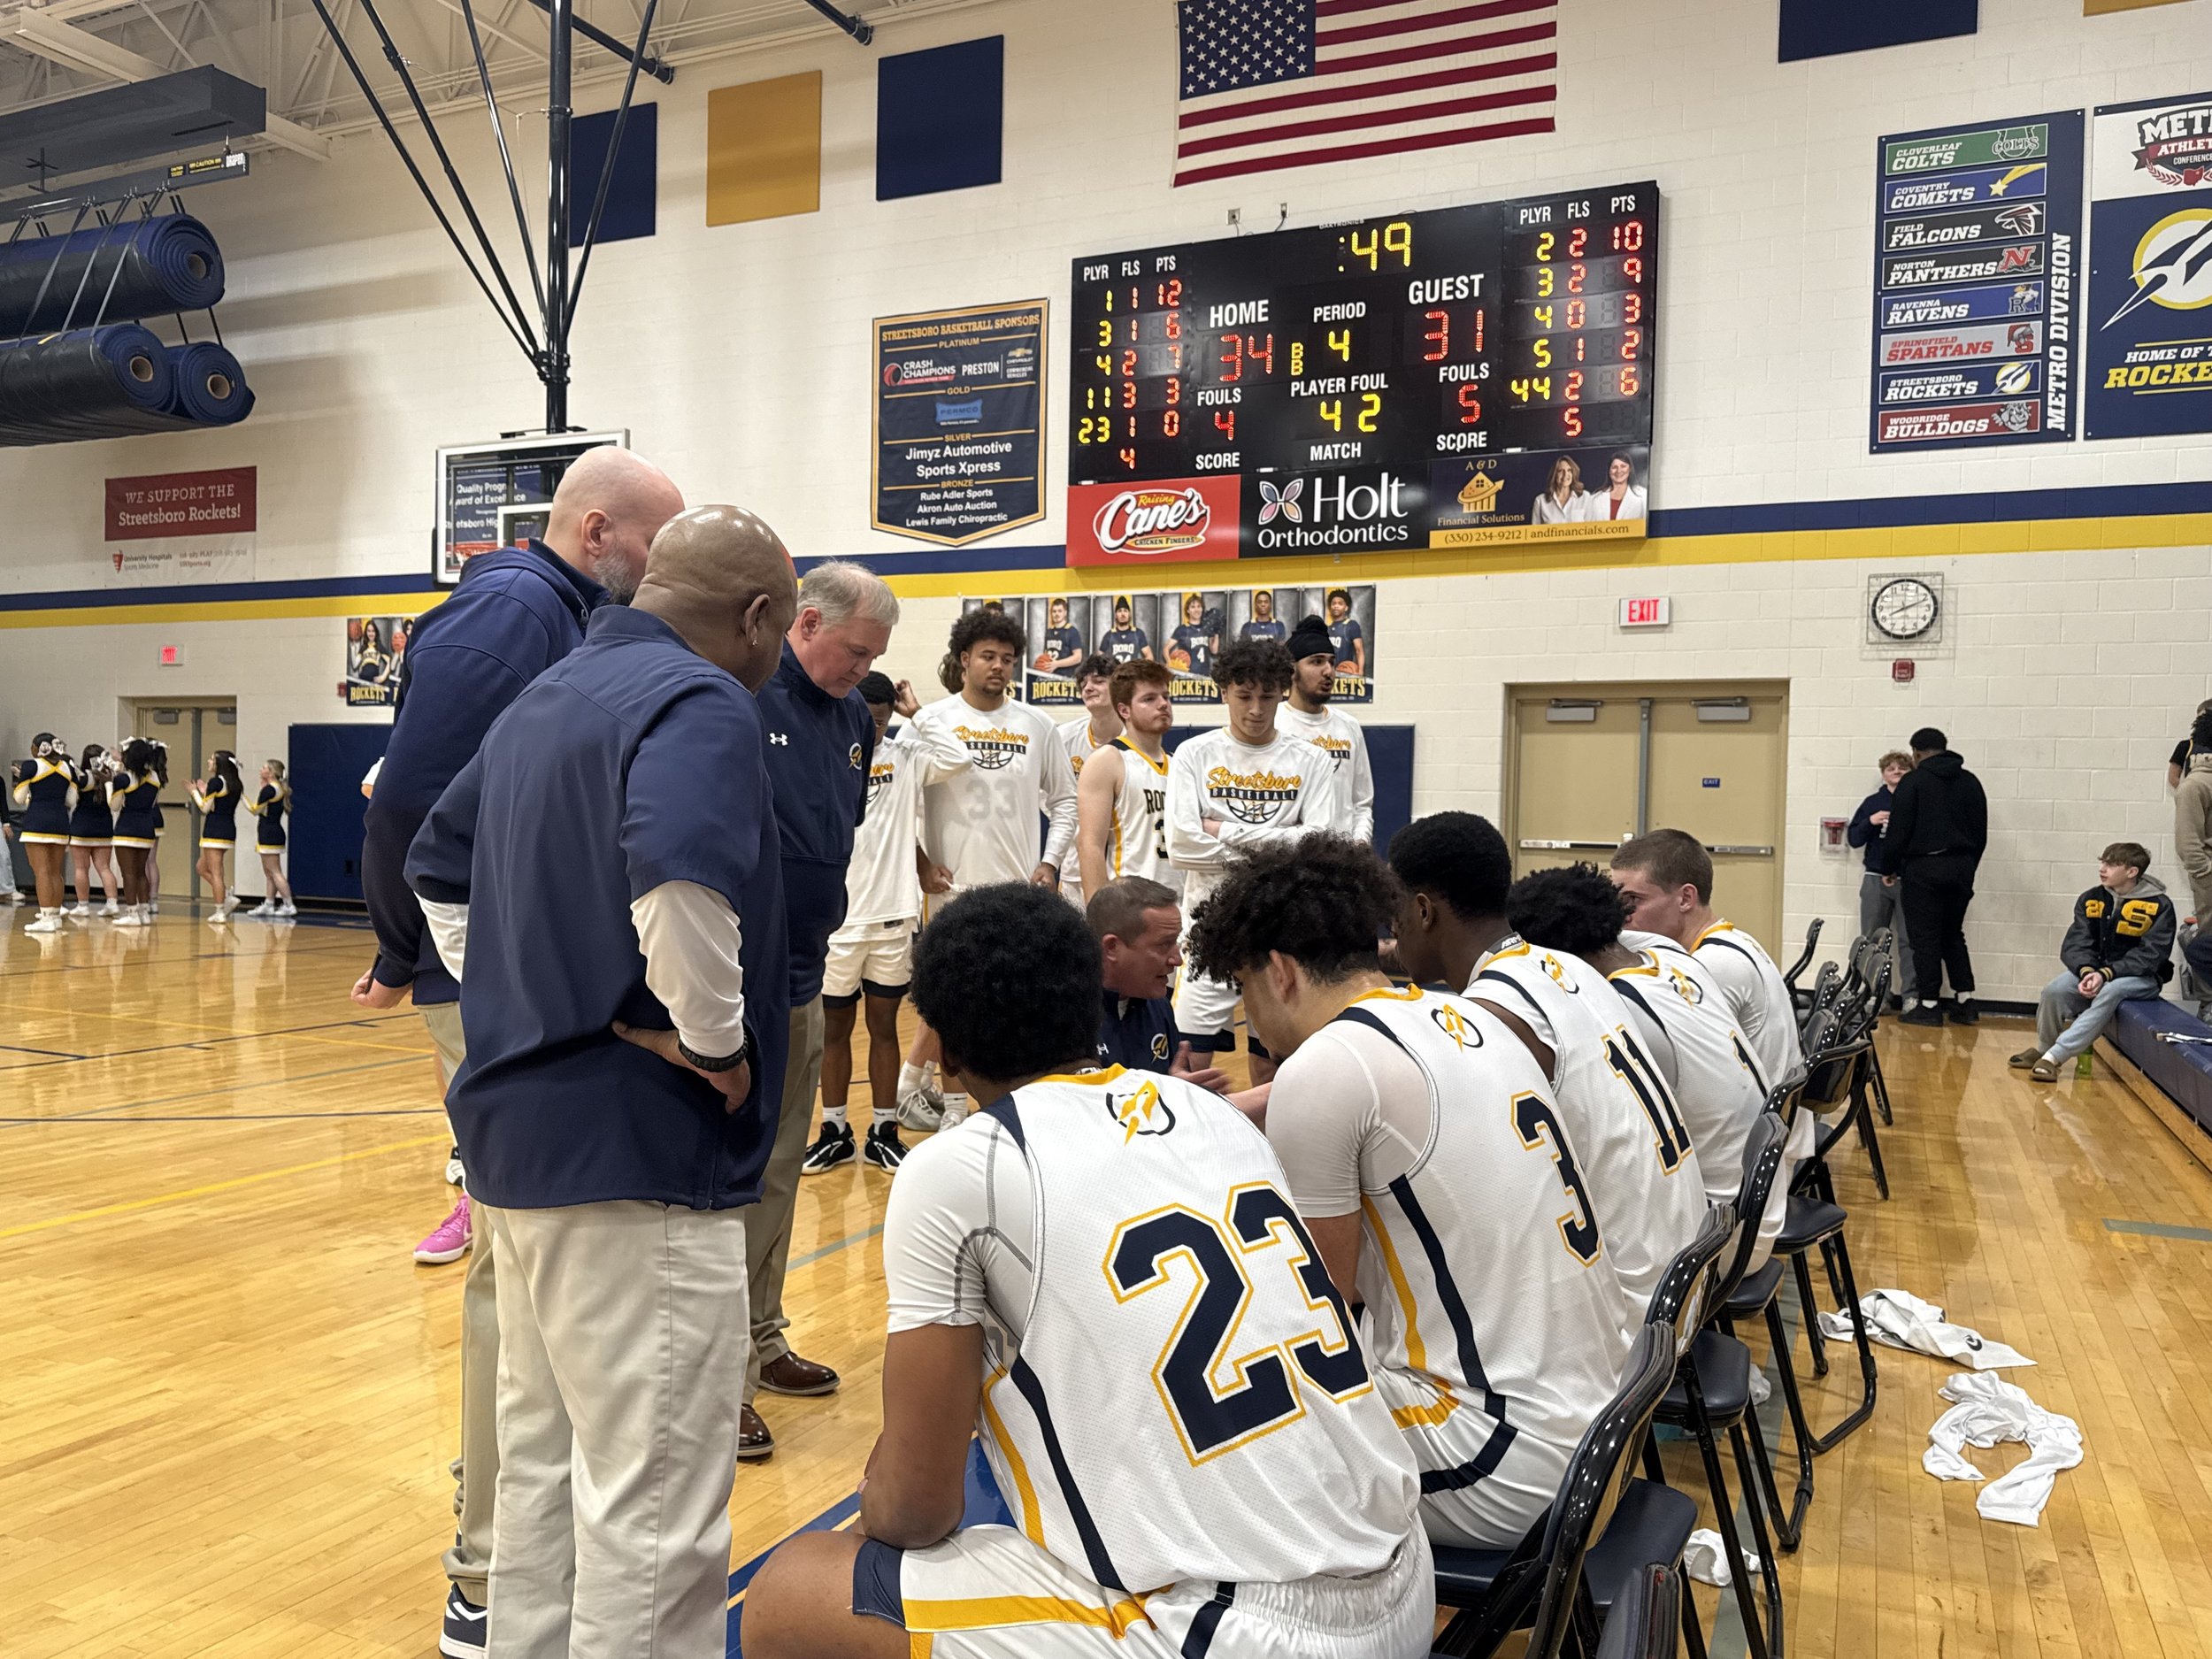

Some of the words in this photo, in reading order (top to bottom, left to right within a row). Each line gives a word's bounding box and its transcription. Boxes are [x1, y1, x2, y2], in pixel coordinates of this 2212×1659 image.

[1896, 142, 1962, 157] CLOVERLEAF
[1992, 134, 2040, 155] COLTS
[196, 158, 214, 168] CAUTION
[1892, 151, 1955, 171] COLTS
[1890, 187, 1975, 210] COMETS
[1894, 181, 1951, 196] COVENTRY
[1519, 205, 1551, 226] PLYR
[1567, 200, 1590, 219] FLS
[1610, 195, 1636, 214] PTS
[1888, 225, 1982, 248] FALCONS
[1893, 222, 1924, 235] FIELD
[1536, 232, 1555, 262] 2
[1569, 227, 1588, 257] 2
[1613, 220, 1643, 251] 10
[1084, 265, 1110, 282] PLYR
[1122, 260, 1140, 277] FLS
[1156, 256, 1176, 273] PTS
[1887, 261, 1998, 285] PANTHERS
[1892, 259, 1935, 272] NORTON
[1538, 267, 1554, 297] 3
[1568, 263, 1586, 294] 2
[1623, 257, 1642, 284] 9
[2050, 233, 2070, 342] DIVISION
[1106, 289, 1112, 311] 1
[1132, 287, 1139, 309] 1
[1158, 278, 1182, 308] 12
[1408, 273, 1485, 305] GUEST
[1210, 299, 1269, 328] HOME
[1313, 301, 1366, 323] PERIOD
[1534, 304, 1553, 329] 4
[1566, 299, 1586, 330] 0
[1624, 293, 1642, 325] 3
[1886, 303, 1970, 325] RAVENS
[1892, 298, 1941, 311] RAVENNA
[882, 325, 939, 342] STREETSBORO
[939, 319, 993, 335] BASKETBALL
[995, 314, 1040, 329] SPONSORS
[1099, 319, 1113, 347] 3
[1132, 319, 1138, 342] 1
[1166, 311, 1182, 340] 6
[1424, 309, 1484, 361] 31
[939, 338, 979, 349] PLATINUM
[1328, 328, 1350, 362] 4
[1532, 338, 1552, 369] 5
[1577, 337, 1585, 362] 1
[1621, 329, 1640, 360] 2
[1886, 341, 1993, 361] SPARTANS
[1891, 335, 1958, 349] SPRINGFIELD
[903, 359, 933, 370] CRASH
[1096, 354, 1111, 376] 4
[1122, 349, 1137, 377] 2
[1167, 344, 1181, 369] 7
[1220, 333, 1274, 381] 34
[2124, 349, 2177, 363] HOME
[2180, 346, 2204, 359] OF
[903, 366, 956, 379] CHAMPIONS
[962, 361, 1000, 376] PRESTON
[1439, 362, 1490, 384] FOULS
[947, 386, 971, 396] GOLD
[1291, 376, 1346, 397] PLAYER
[1350, 372, 1388, 393] FOUL
[1510, 376, 1551, 403] 44
[1564, 371, 1584, 401] 2
[1620, 365, 1640, 396] 6
[1885, 380, 1978, 402] ROCKETS
[1889, 374, 1963, 388] STREETSBORO
[2047, 346, 2068, 431] METRO
[1087, 387, 1110, 410] 11
[1123, 381, 1137, 409] 3
[1166, 377, 1180, 404] 3
[1197, 388, 1241, 407] FOULS
[1458, 383, 1481, 424] 5
[941, 406, 979, 415] PERMCO
[1319, 399, 1341, 432] 4
[1358, 393, 1380, 433] 2
[1888, 413, 1950, 426] WOODRIDGE
[1078, 416, 1110, 443] 23
[1129, 416, 1136, 437] 1
[1164, 410, 1179, 436] 0
[1214, 410, 1234, 441] 4
[1563, 407, 1582, 437] 5
[1884, 416, 1989, 439] BULLDOGS
[944, 433, 972, 442] SILVER
[1436, 431, 1487, 452] SCORE
[905, 446, 941, 461] Jimyz
[942, 441, 1012, 457] Automotive
[1119, 448, 1135, 470] 4
[1196, 452, 1240, 471] SCORE
[1310, 442, 1361, 461] MATCH
[916, 463, 956, 479] Sports
[958, 459, 1001, 476] Xpress
[1465, 460, 1474, 472] A
[1476, 460, 1486, 471] &
[1487, 459, 1497, 470] D
[126, 492, 144, 504] WE
[147, 486, 205, 503] SUPPORT
[208, 483, 234, 498] THE
[457, 483, 483, 495] Quality
[941, 480, 973, 488] BRONZE
[942, 489, 964, 500] Adler
[966, 488, 994, 499] Sports
[475, 495, 484, 504] of
[917, 503, 941, 513] Akron
[943, 502, 964, 512] Auto
[964, 500, 997, 511] Auction
[1138, 494, 1175, 506] Raising
[1313, 472, 1408, 523] Holt
[119, 507, 186, 526] Streetsboro
[188, 503, 242, 522] Rockets!
[906, 518, 929, 527] Lewis
[930, 515, 956, 527] Family
[958, 512, 1008, 526] Chiropractic
[1101, 487, 1207, 550] Cane's
[1437, 514, 1480, 526] Financial
[1481, 511, 1525, 525] Solutions
[1133, 536, 1165, 546] CHICKEN
[1166, 535, 1197, 545] FINGERS
[1257, 522, 1409, 549] Orthodontics
[1444, 532, 1473, 544] (330)
[1475, 530, 1522, 543] 234-9212
[1530, 525, 1629, 538] andfinancials.com
[1629, 600, 1659, 622] EXIT
[1196, 647, 1205, 663] 4
[350, 686, 386, 702] ROCKETS
[1206, 766, 1302, 789] Streetsboro
[1211, 787, 1296, 800] BASKETBALL
[2085, 899, 2105, 918] 21
[2116, 899, 2160, 937] S
[1601, 1023, 1693, 1177] 11
[1509, 1090, 1601, 1268] 3
[1102, 1180, 1373, 1468] 23
